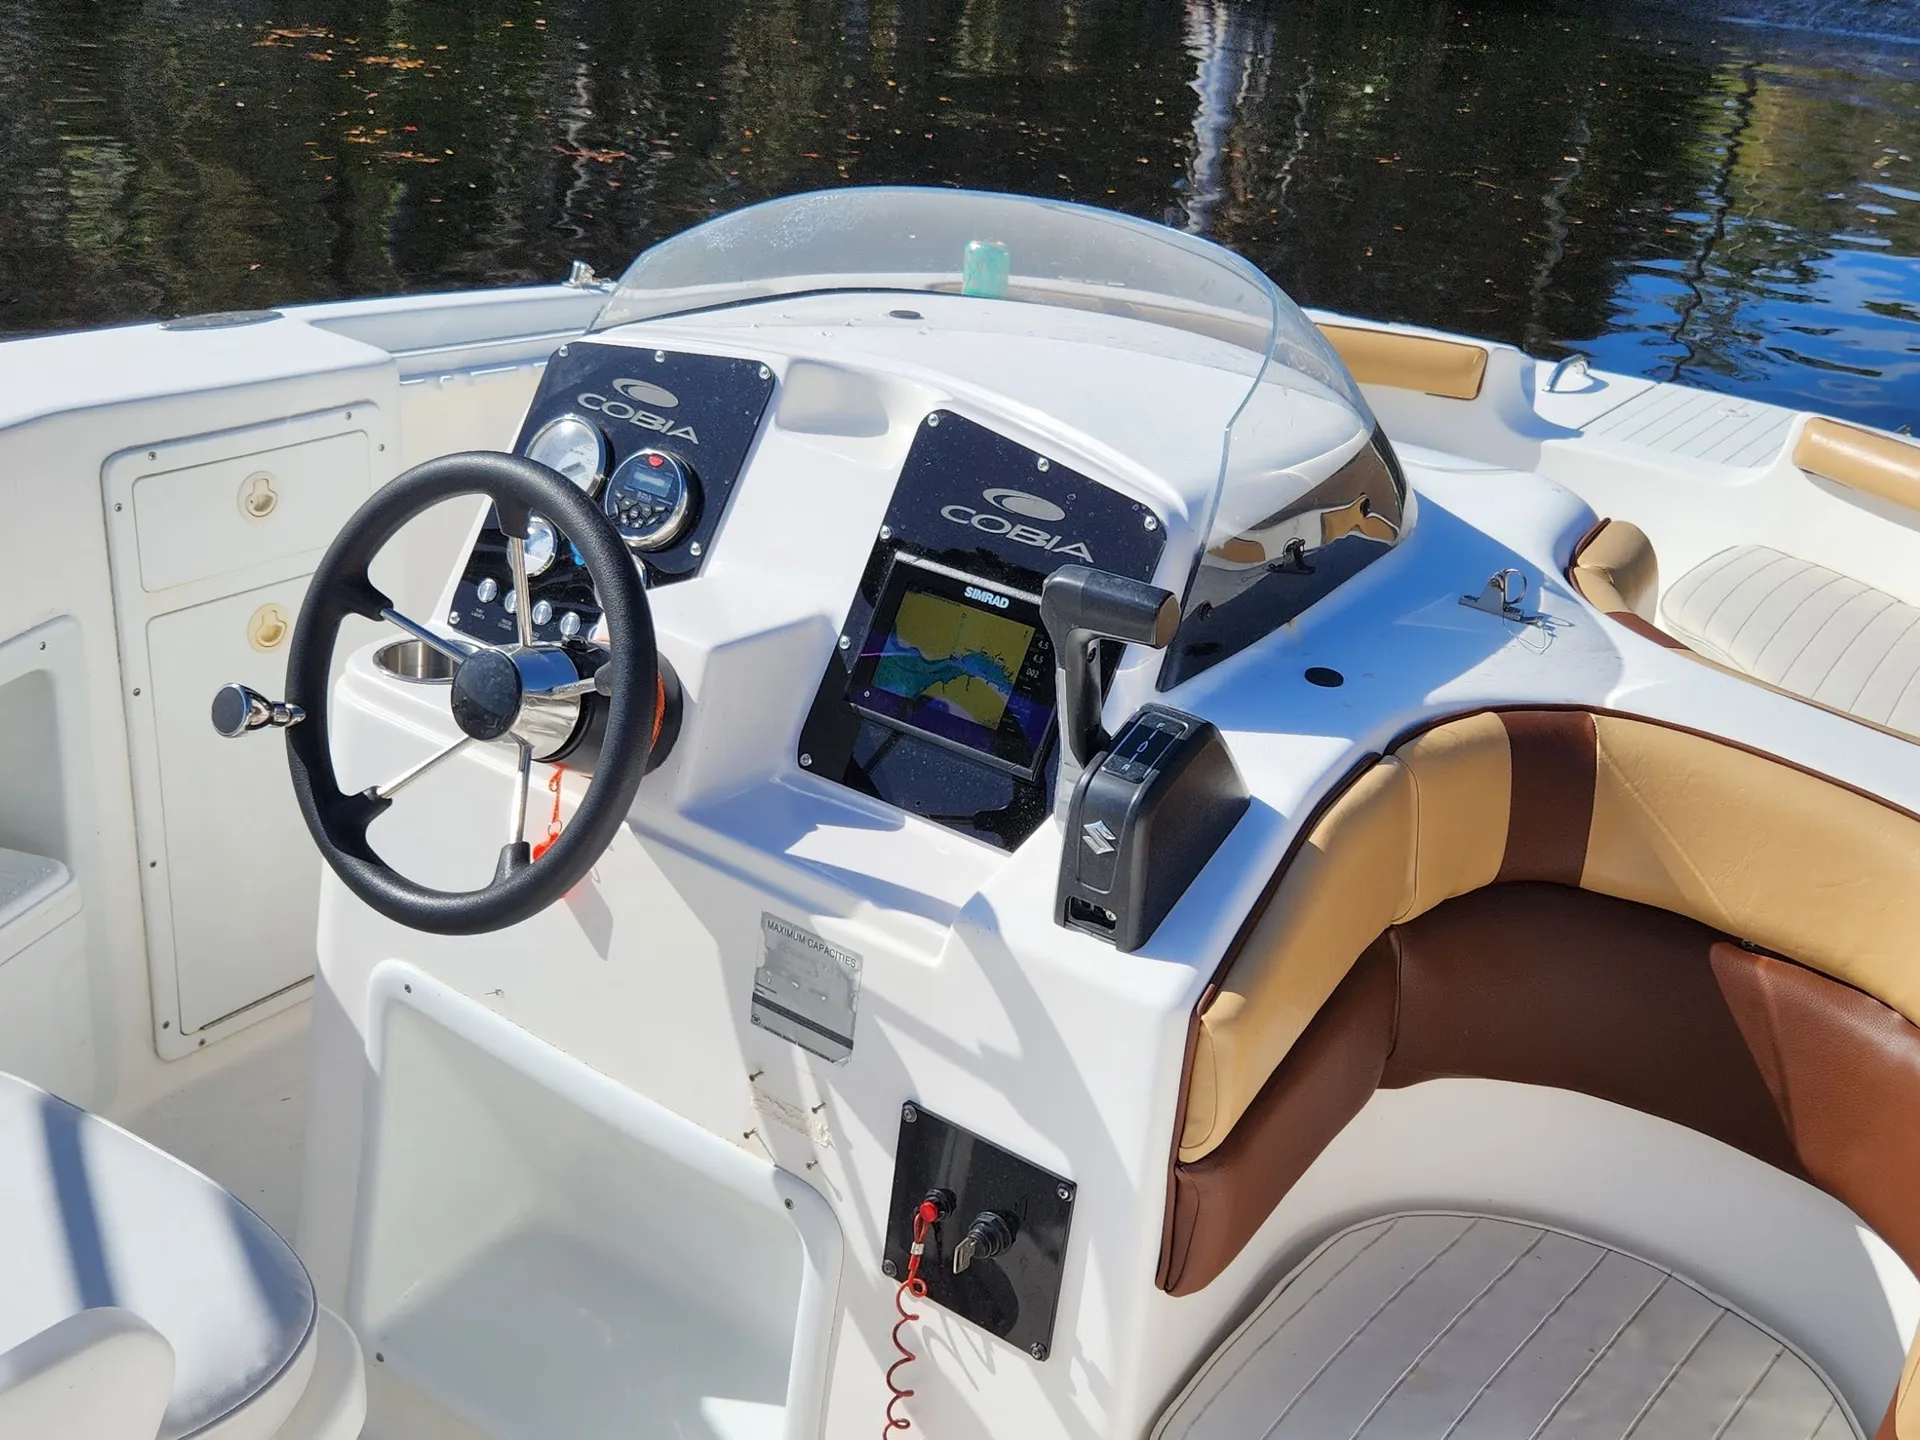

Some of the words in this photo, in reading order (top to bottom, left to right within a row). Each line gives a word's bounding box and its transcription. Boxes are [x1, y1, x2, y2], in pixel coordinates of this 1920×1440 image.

[577, 393, 699, 445] COBIA
[940, 504, 1095, 563] COBIA
[963, 586, 1010, 609] SIMRAD
[1037, 640, 1050, 650] 4.5
[1032, 654, 1044, 664] 4.5
[1025, 667, 1040, 679] 002
[767, 919, 806, 945] MAXIMUM
[807, 938, 857, 969] CAPACITIES
